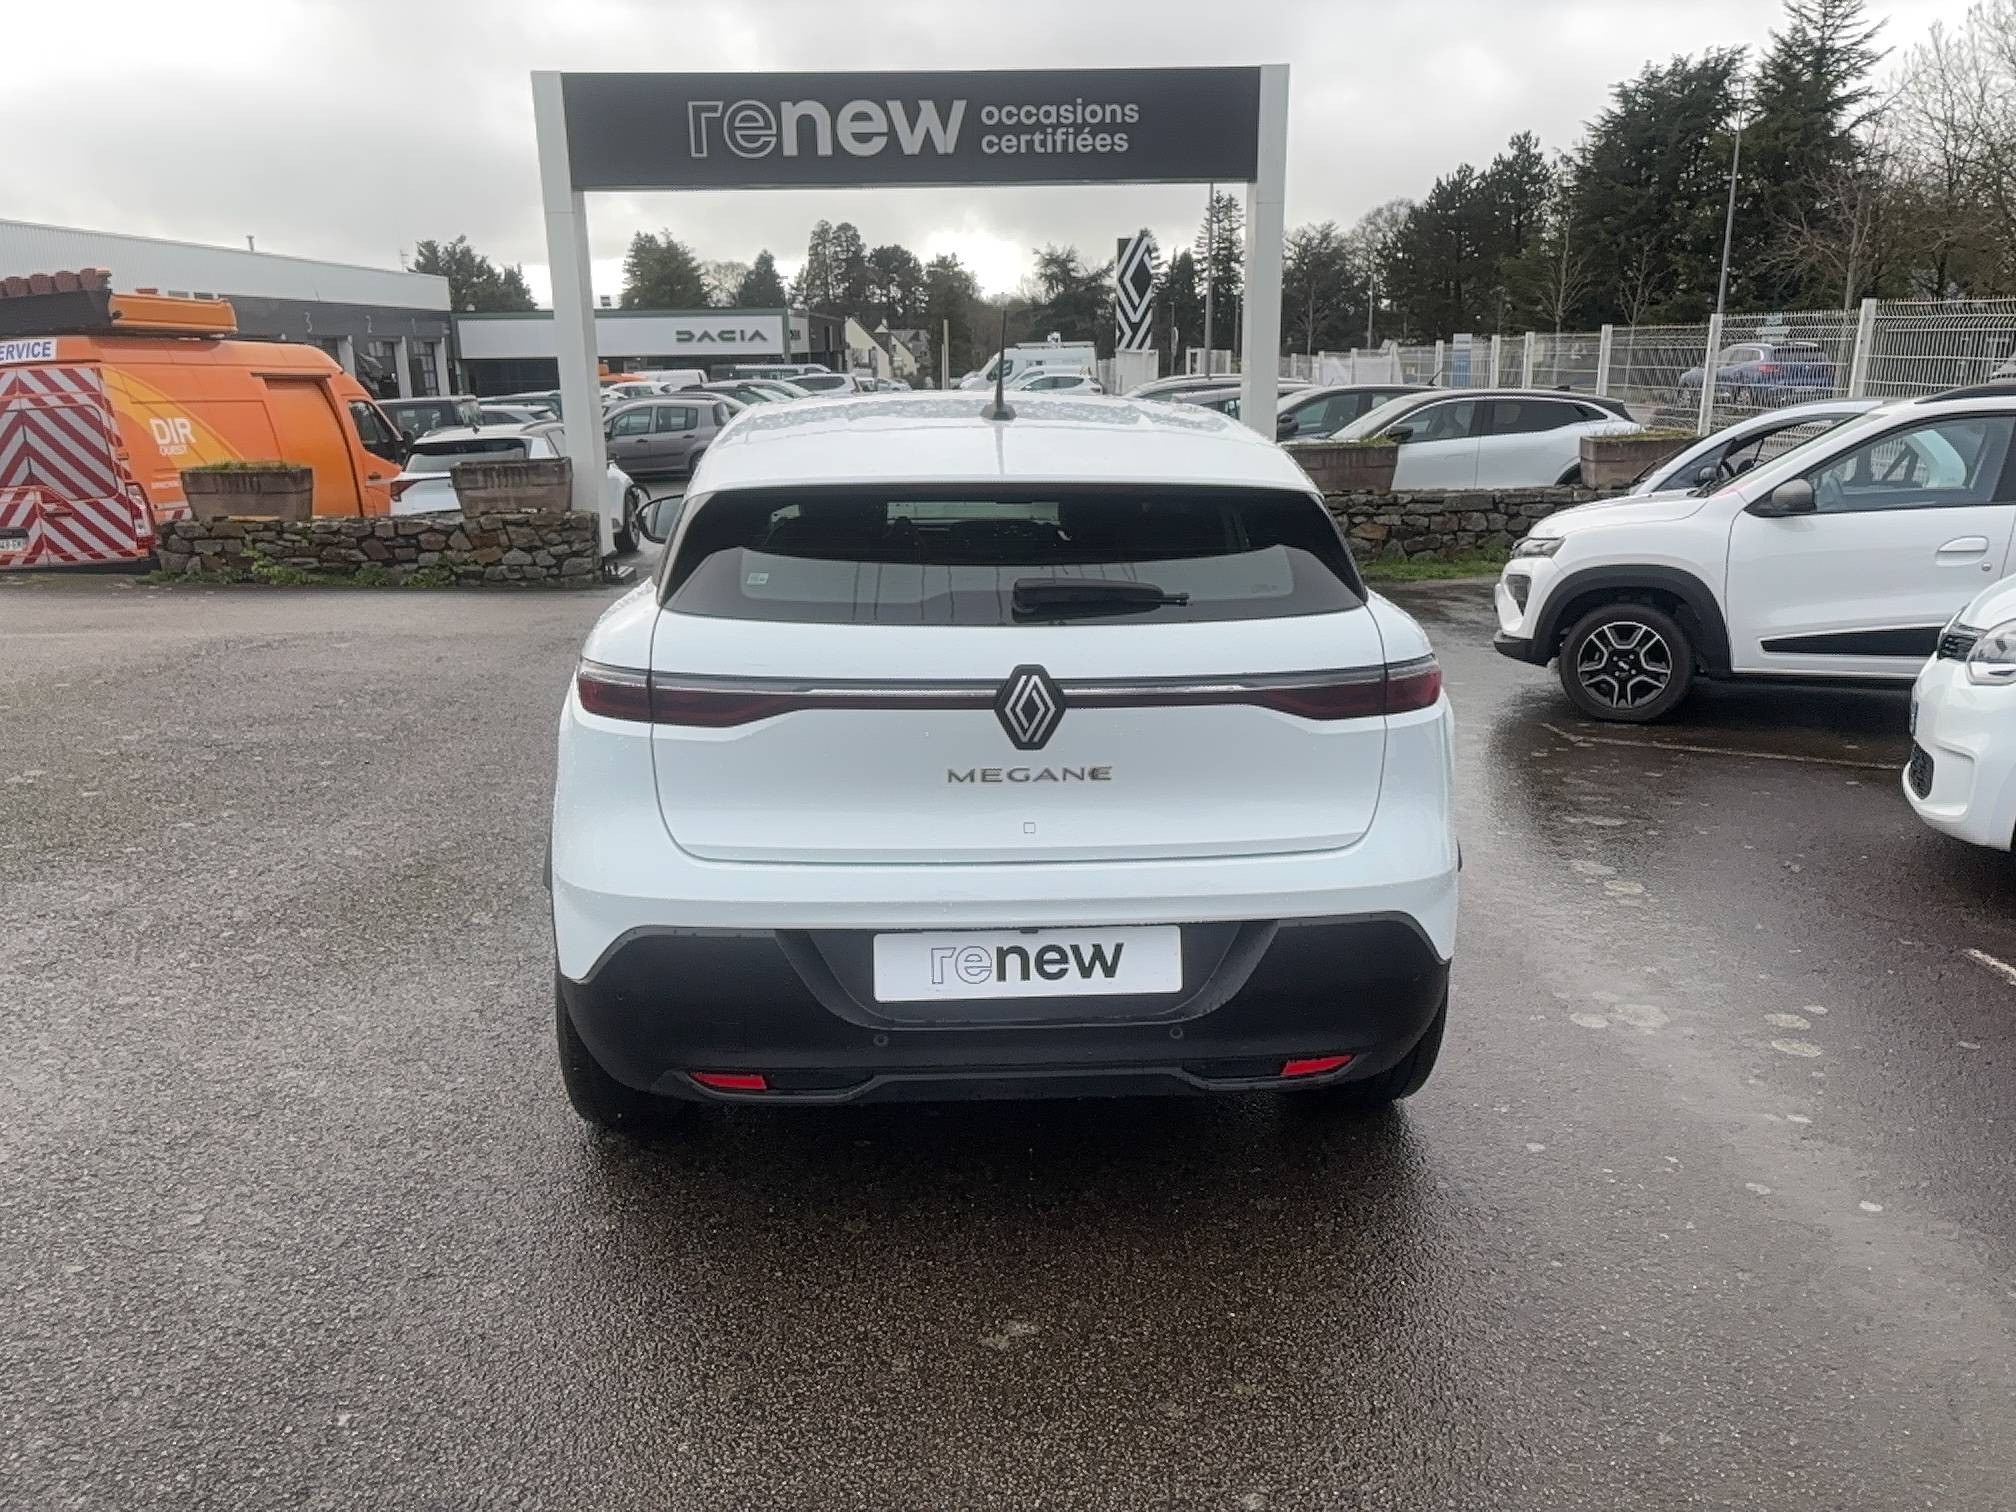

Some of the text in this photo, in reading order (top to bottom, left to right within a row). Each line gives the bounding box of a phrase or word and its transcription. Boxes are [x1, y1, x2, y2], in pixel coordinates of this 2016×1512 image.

[980, 98, 1140, 125] occasions
[687, 99, 967, 158] renew
[981, 127, 1130, 154] certifiées
[675, 329, 769, 342] DACIA
[149, 416, 197, 445] DIR
[947, 766, 1113, 784] MEGANE
[931, 942, 1125, 985] renew
